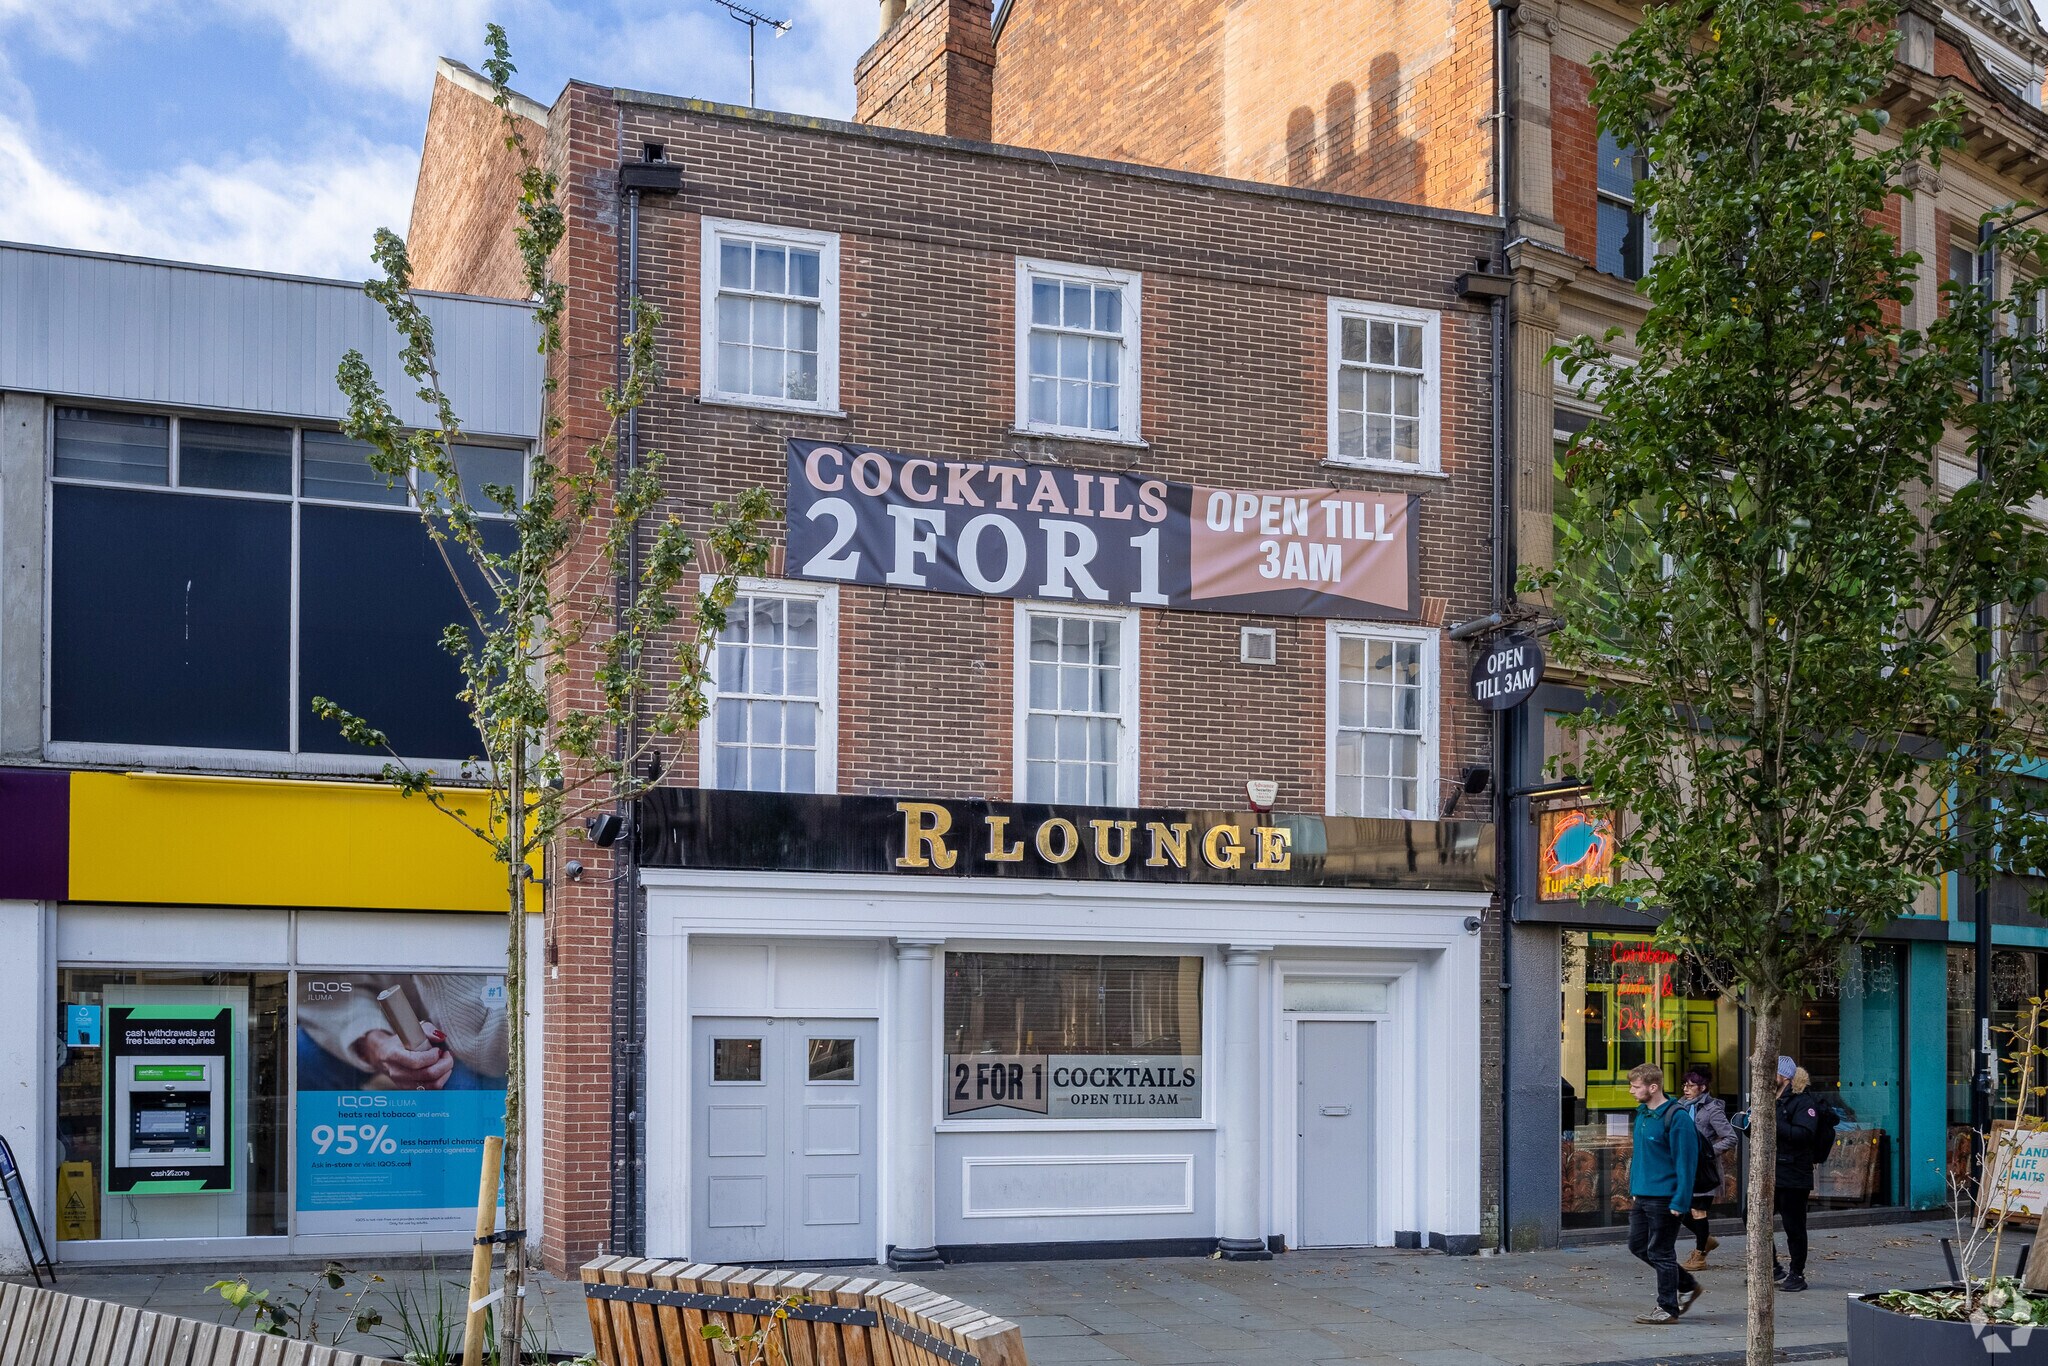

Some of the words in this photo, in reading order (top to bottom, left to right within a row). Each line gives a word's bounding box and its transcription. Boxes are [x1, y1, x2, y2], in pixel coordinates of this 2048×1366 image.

[805, 447, 1168, 524] COCKTAILS
[1206, 491, 1308, 536] OPEN
[1322, 499, 1394, 541] TILL
[802, 497, 861, 580] 2
[886, 503, 1109, 601] FOR
[1130, 527, 1169, 605] 1
[1258, 539, 1342, 583] 3AM
[1487, 646, 1524, 675] OPEN
[1476, 678, 1501, 701] TILL
[1504, 667, 1535, 693] 3AM
[896, 801, 958, 870] R
[985, 815, 1292, 872] LOUNGE
[308, 981, 353, 993] IQOS
[488, 986, 503, 997] #1
[125, 1029, 146, 1037] cash
[148, 1028, 198, 1037] withdrawals
[199, 1028, 216, 1037] and
[125, 1036, 143, 1045] free
[144, 1036, 176, 1045] balance
[178, 1036, 216, 1046] enquiries
[954, 1064, 970, 1100] 2
[976, 1063, 1024, 1100] FOR
[1032, 1064, 1042, 1100] 1
[1053, 1067, 1196, 1088] COCKTAILS
[337, 1095, 387, 1108] IQOS
[1070, 1093, 1109, 1105] OPEN
[1113, 1093, 1145, 1105] TILL
[1148, 1093, 1179, 1105] 3AM
[338, 1110, 363, 1119] heats
[364, 1110, 380, 1118] real
[382, 1109, 416, 1118] tobacco
[311, 1124, 397, 1155] 95%
[400, 1137, 416, 1146] less
[418, 1136, 450, 1145] harmful
[451, 1136, 484, 1145] chemica
[400, 1147, 433, 1155] compared
[325, 1160, 353, 1168] in-store
[378, 1158, 412, 1168] IQOS.com
[2015, 1158, 2038, 1169] LIFE
[2002, 1170, 2045, 1182] AWAITS
